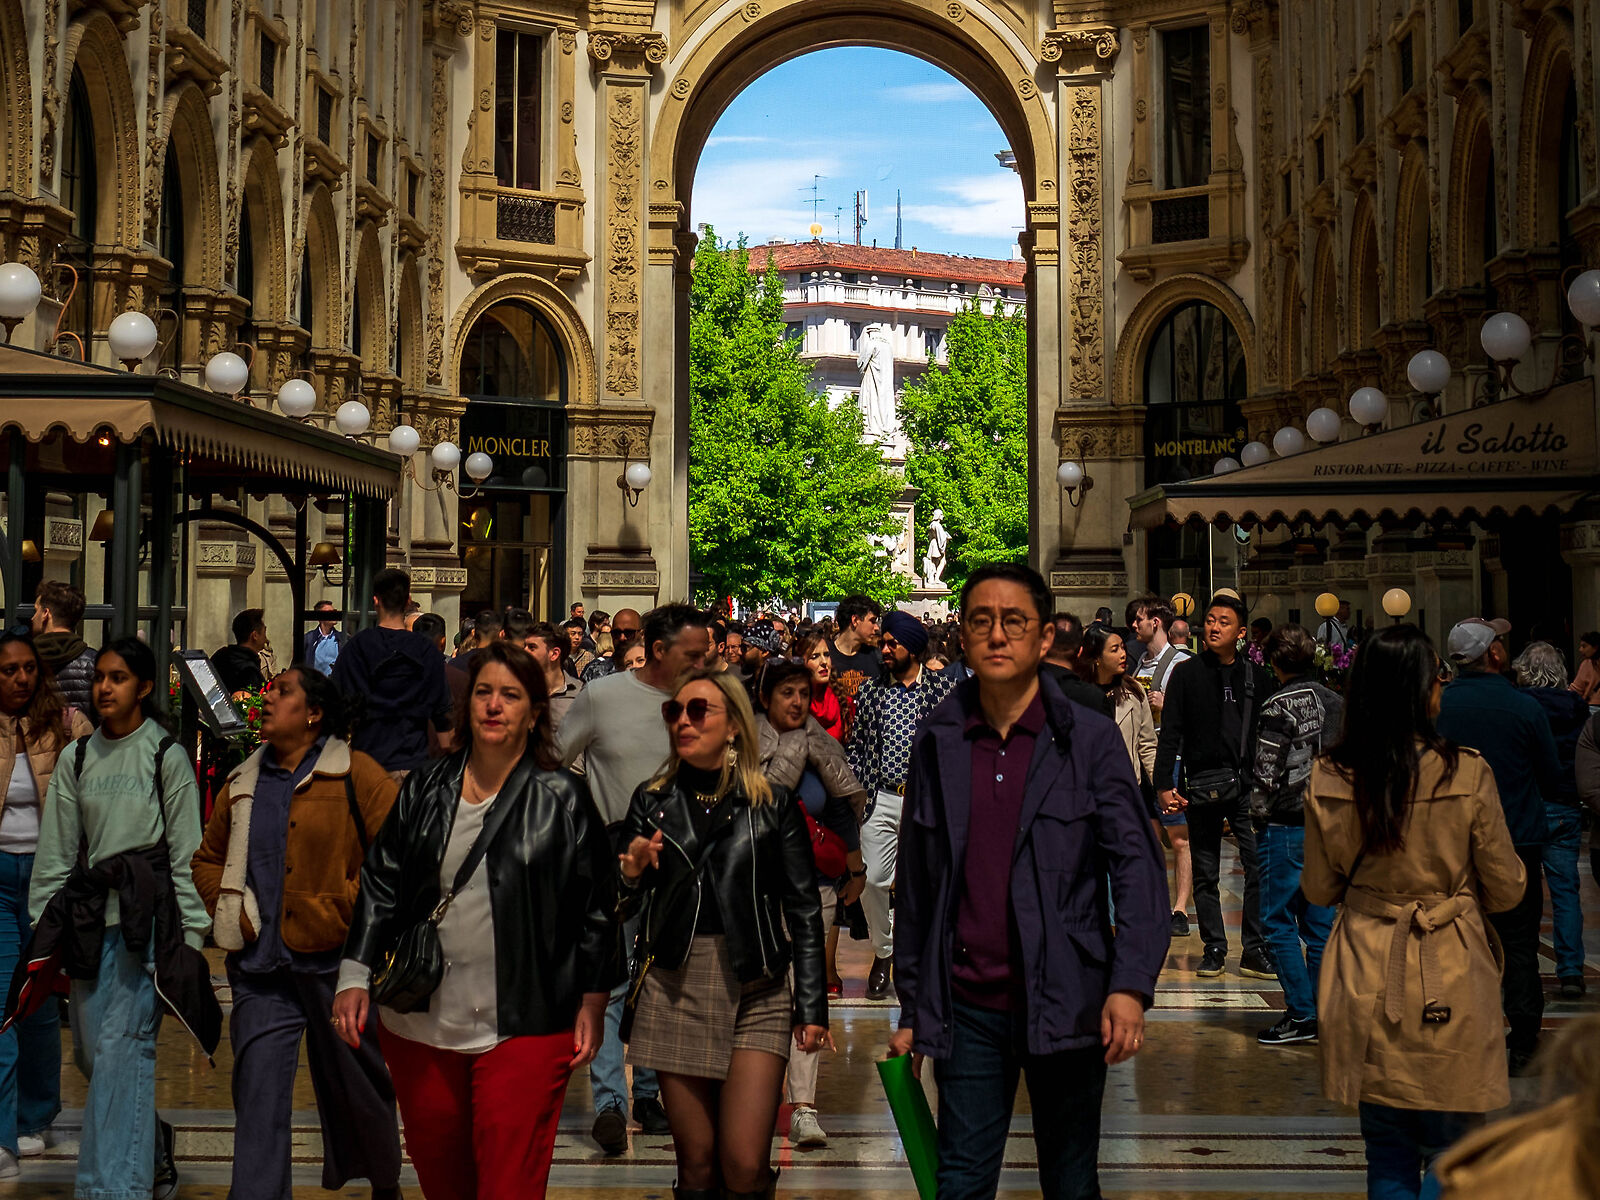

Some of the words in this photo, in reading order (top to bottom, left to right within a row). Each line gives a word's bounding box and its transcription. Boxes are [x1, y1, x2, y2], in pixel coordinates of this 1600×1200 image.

[468, 435, 551, 457] MONCLER
[1154, 438, 1236, 457] MONTBLANC
[1420, 423, 1447, 455] il
[1456, 422, 1569, 454] Salotto
[1313, 462, 1403, 476] RISTORANTE
[1414, 462, 1457, 474] PIZZA
[1531, 459, 1569, 471] WINE
